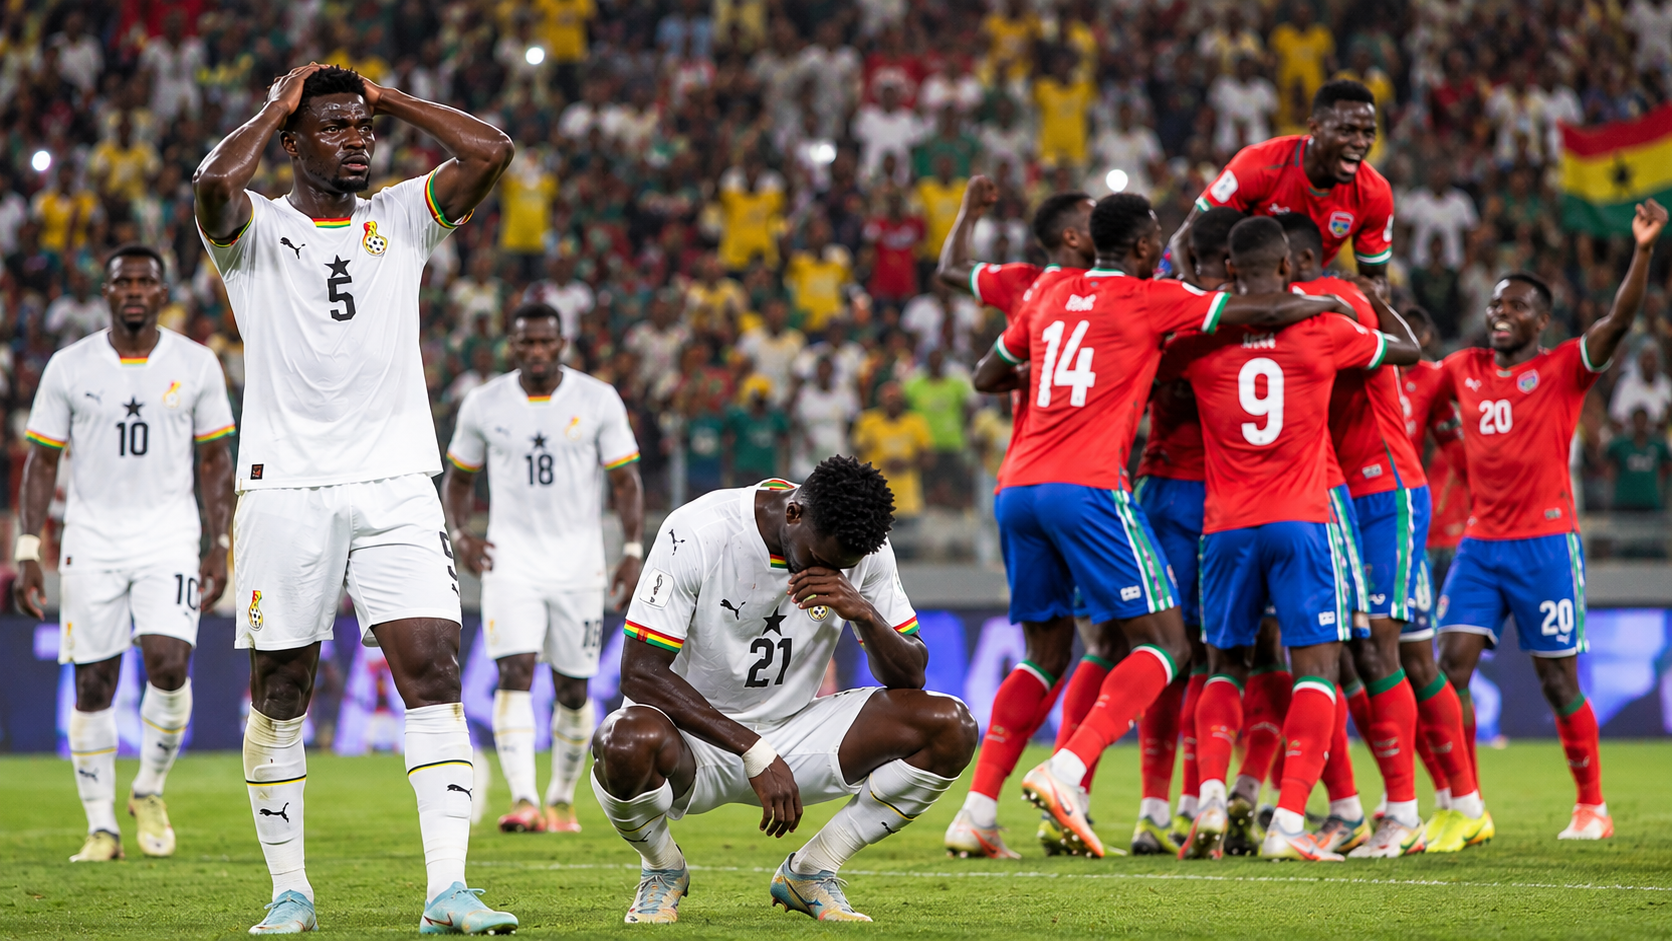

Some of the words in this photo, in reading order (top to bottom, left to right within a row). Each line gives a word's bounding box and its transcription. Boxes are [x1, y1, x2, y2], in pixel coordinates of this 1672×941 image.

[328, 274, 356, 322] 5
[1036, 319, 1096, 408] 14
[1238, 357, 1285, 446] 9
[1478, 399, 1512, 434] 20
[116, 421, 149, 457] 10
[524, 453, 554, 486] 18
[175, 573, 201, 611] 10
[1539, 598, 1574, 635] 20
[744, 637, 793, 689] 21
